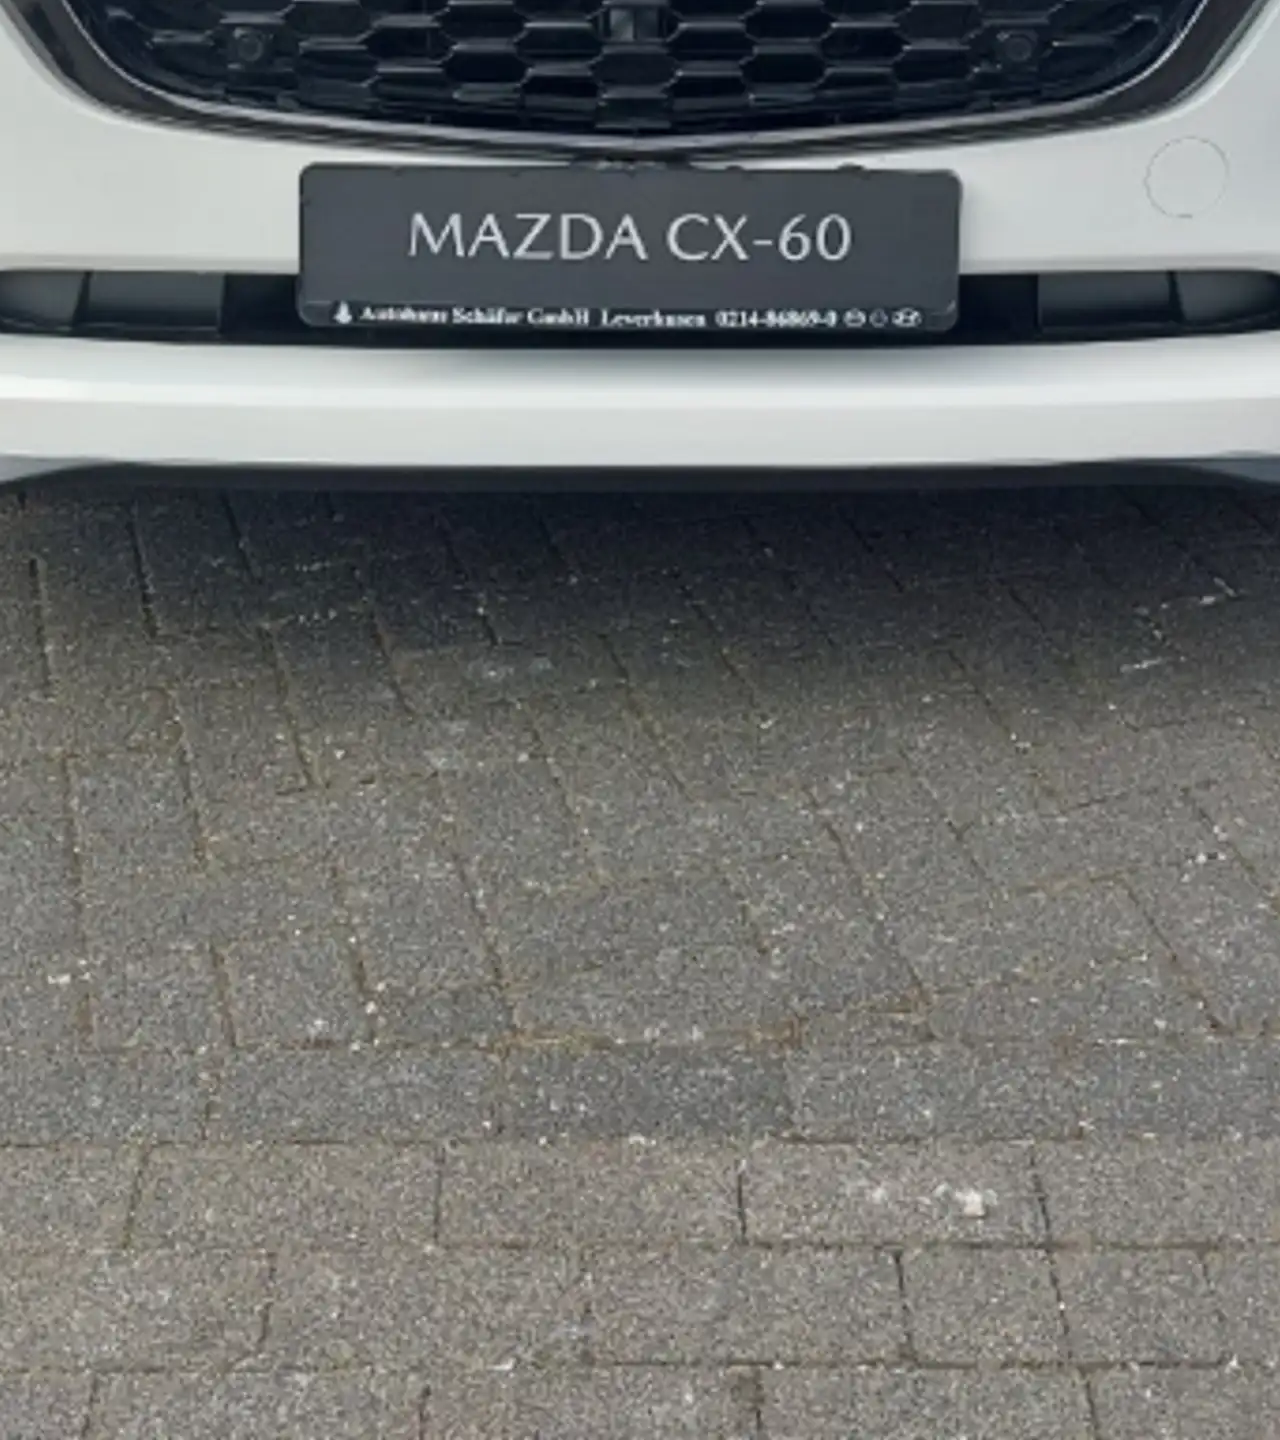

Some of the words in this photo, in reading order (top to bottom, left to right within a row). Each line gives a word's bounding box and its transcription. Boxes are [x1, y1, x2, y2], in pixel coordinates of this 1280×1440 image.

[407, 213, 648, 260] MAZDA
[666, 213, 852, 262] CX-60
[360, 306, 447, 324] Autohaus
[527, 308, 589, 326] GmbH
[601, 307, 707, 328] Leverkusen
